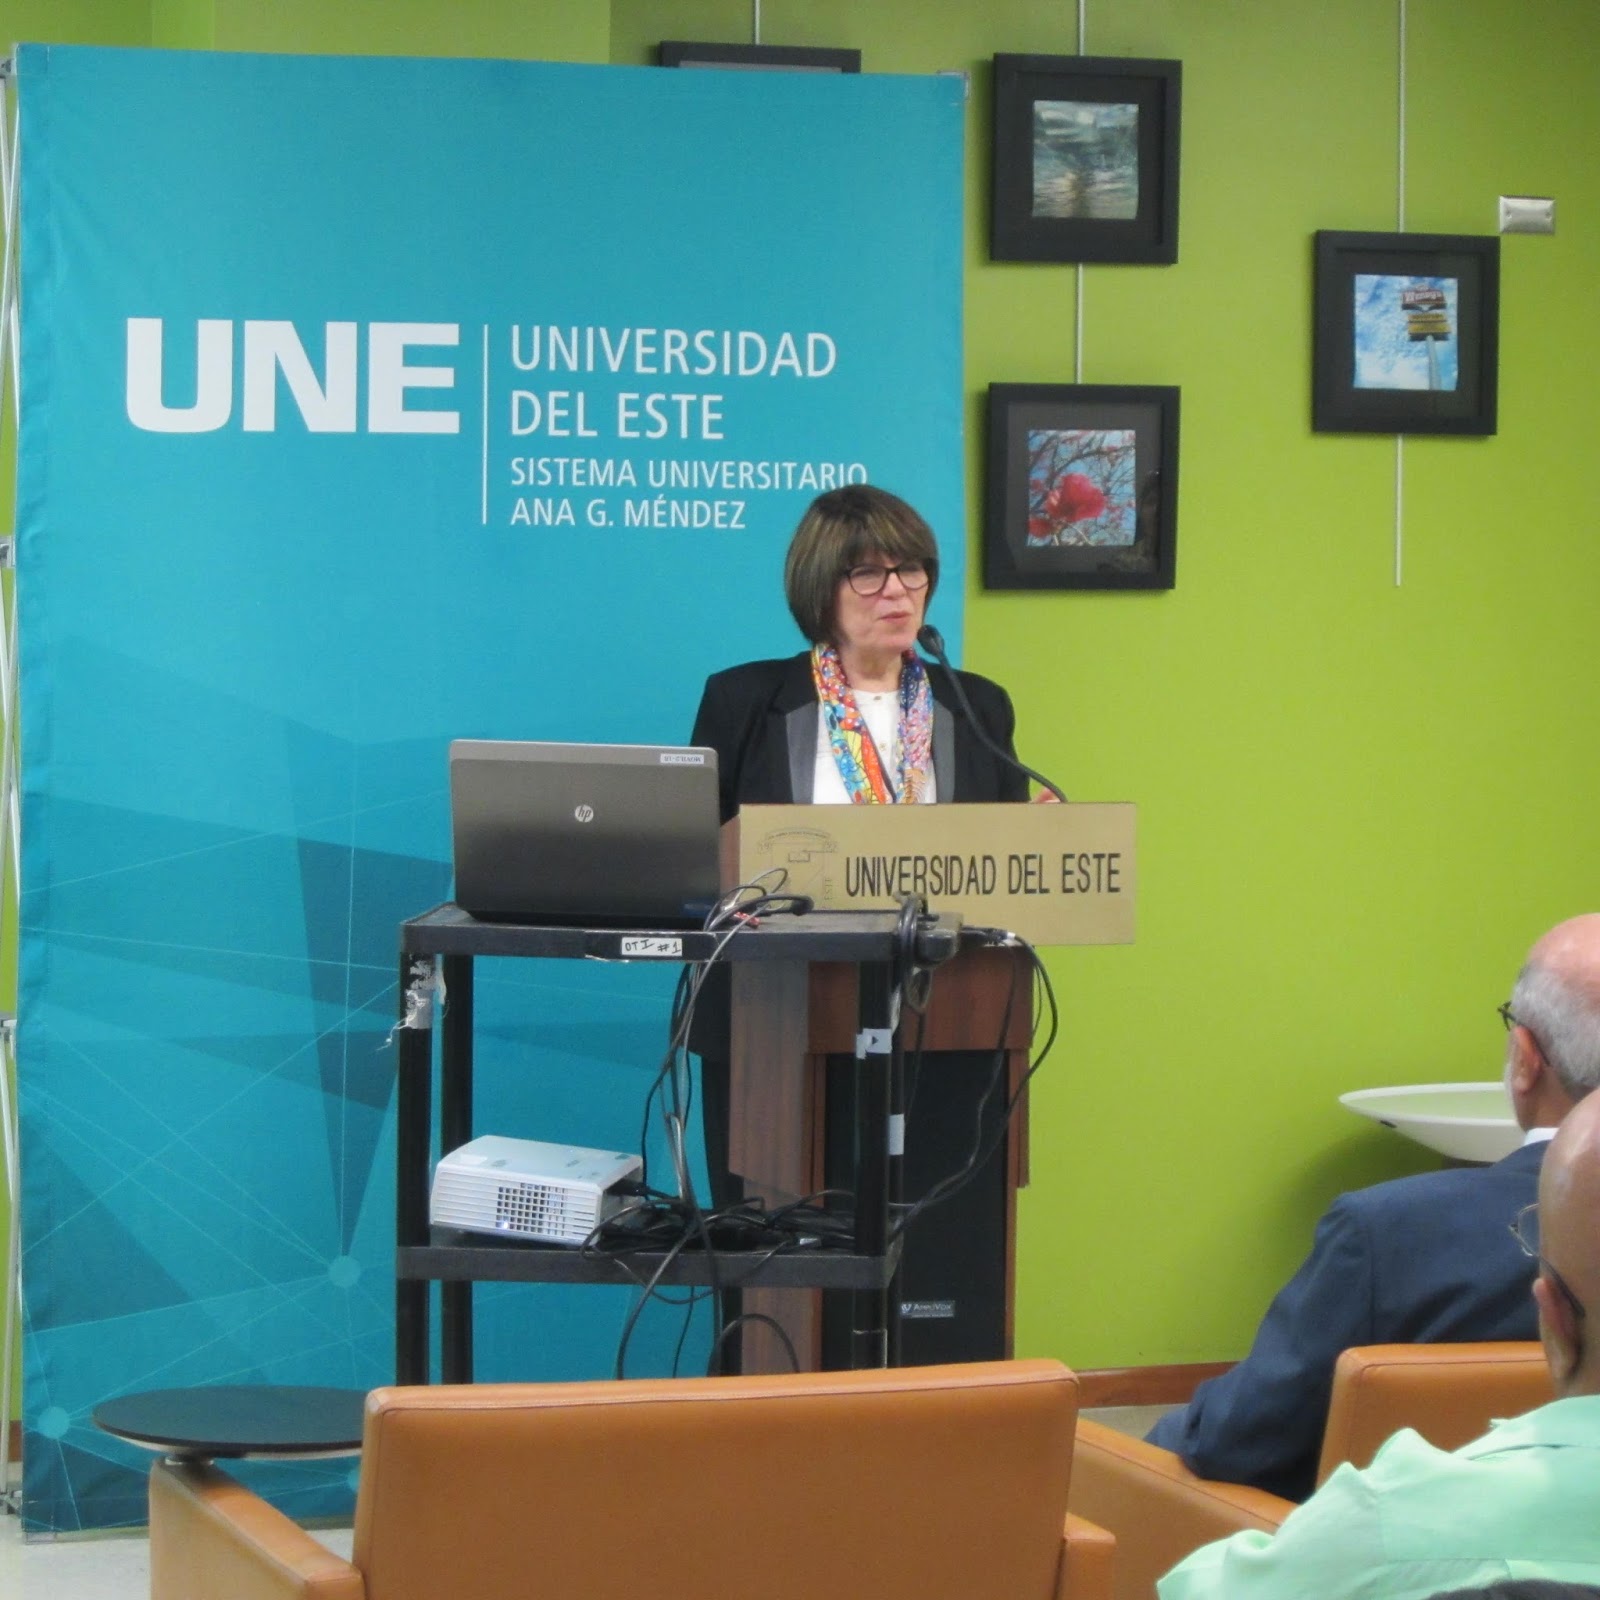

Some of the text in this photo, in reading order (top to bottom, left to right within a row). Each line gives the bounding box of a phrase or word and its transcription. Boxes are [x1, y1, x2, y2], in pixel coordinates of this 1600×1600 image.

[511, 325, 837, 378] UNIVERSIDAD
[126, 317, 460, 434] UNE
[511, 389, 725, 441] DEL ESTE
[511, 457, 868, 490] SISTEMA UNIVERSITARIO
[511, 494, 746, 530] ANA G. MÉNDEZ
[576, 804, 594, 823] hp
[846, 853, 1121, 897] UNIVERSIDAD DEL ESTE
[625, 938, 682, 954] OTI #1
